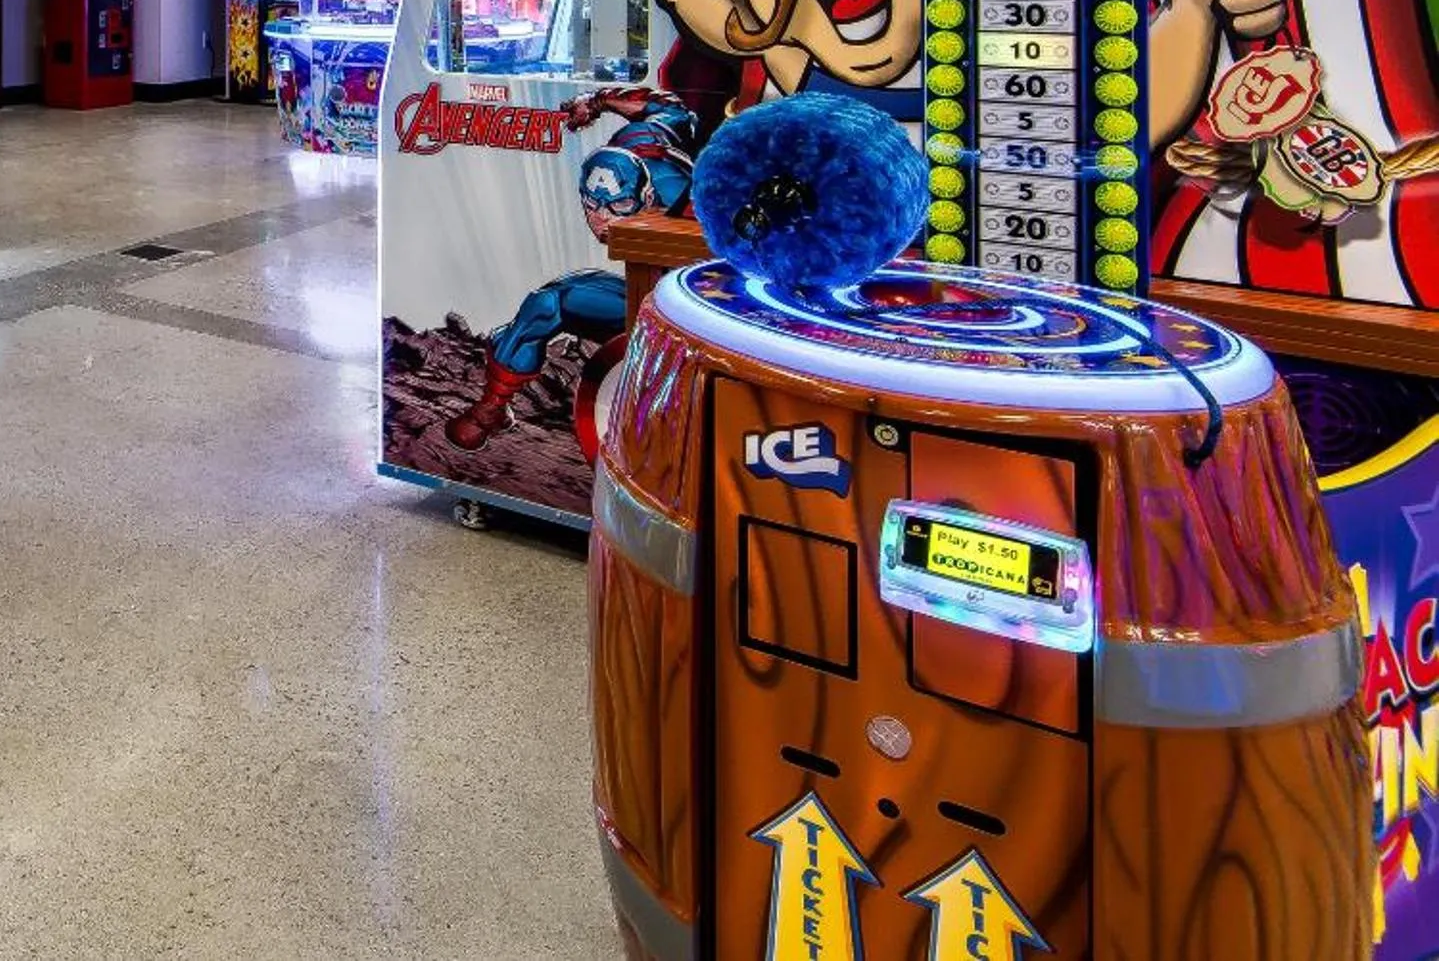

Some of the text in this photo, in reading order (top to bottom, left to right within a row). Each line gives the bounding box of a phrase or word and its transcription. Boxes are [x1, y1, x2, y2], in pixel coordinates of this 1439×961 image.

[1005, 3, 1046, 27] 30
[1010, 42, 1041, 59] 10
[468, 83, 509, 102] MARVEL
[1005, 74, 1047, 98] 60
[1227, 66, 1302, 124] ICE
[395, 82, 570, 155] AVENGERS
[1017, 112, 1033, 130] 5
[1006, 145, 1047, 168] 50
[1307, 136, 1357, 173] GB
[1018, 183, 1033, 201] 5
[1005, 214, 1047, 240] 20
[1011, 254, 1042, 272] 10
[745, 426, 840, 476] ICE
[936, 530, 970, 550] Play
[977, 542, 1019, 561] $1.50
[931, 551, 1026, 585] TROPICANA
